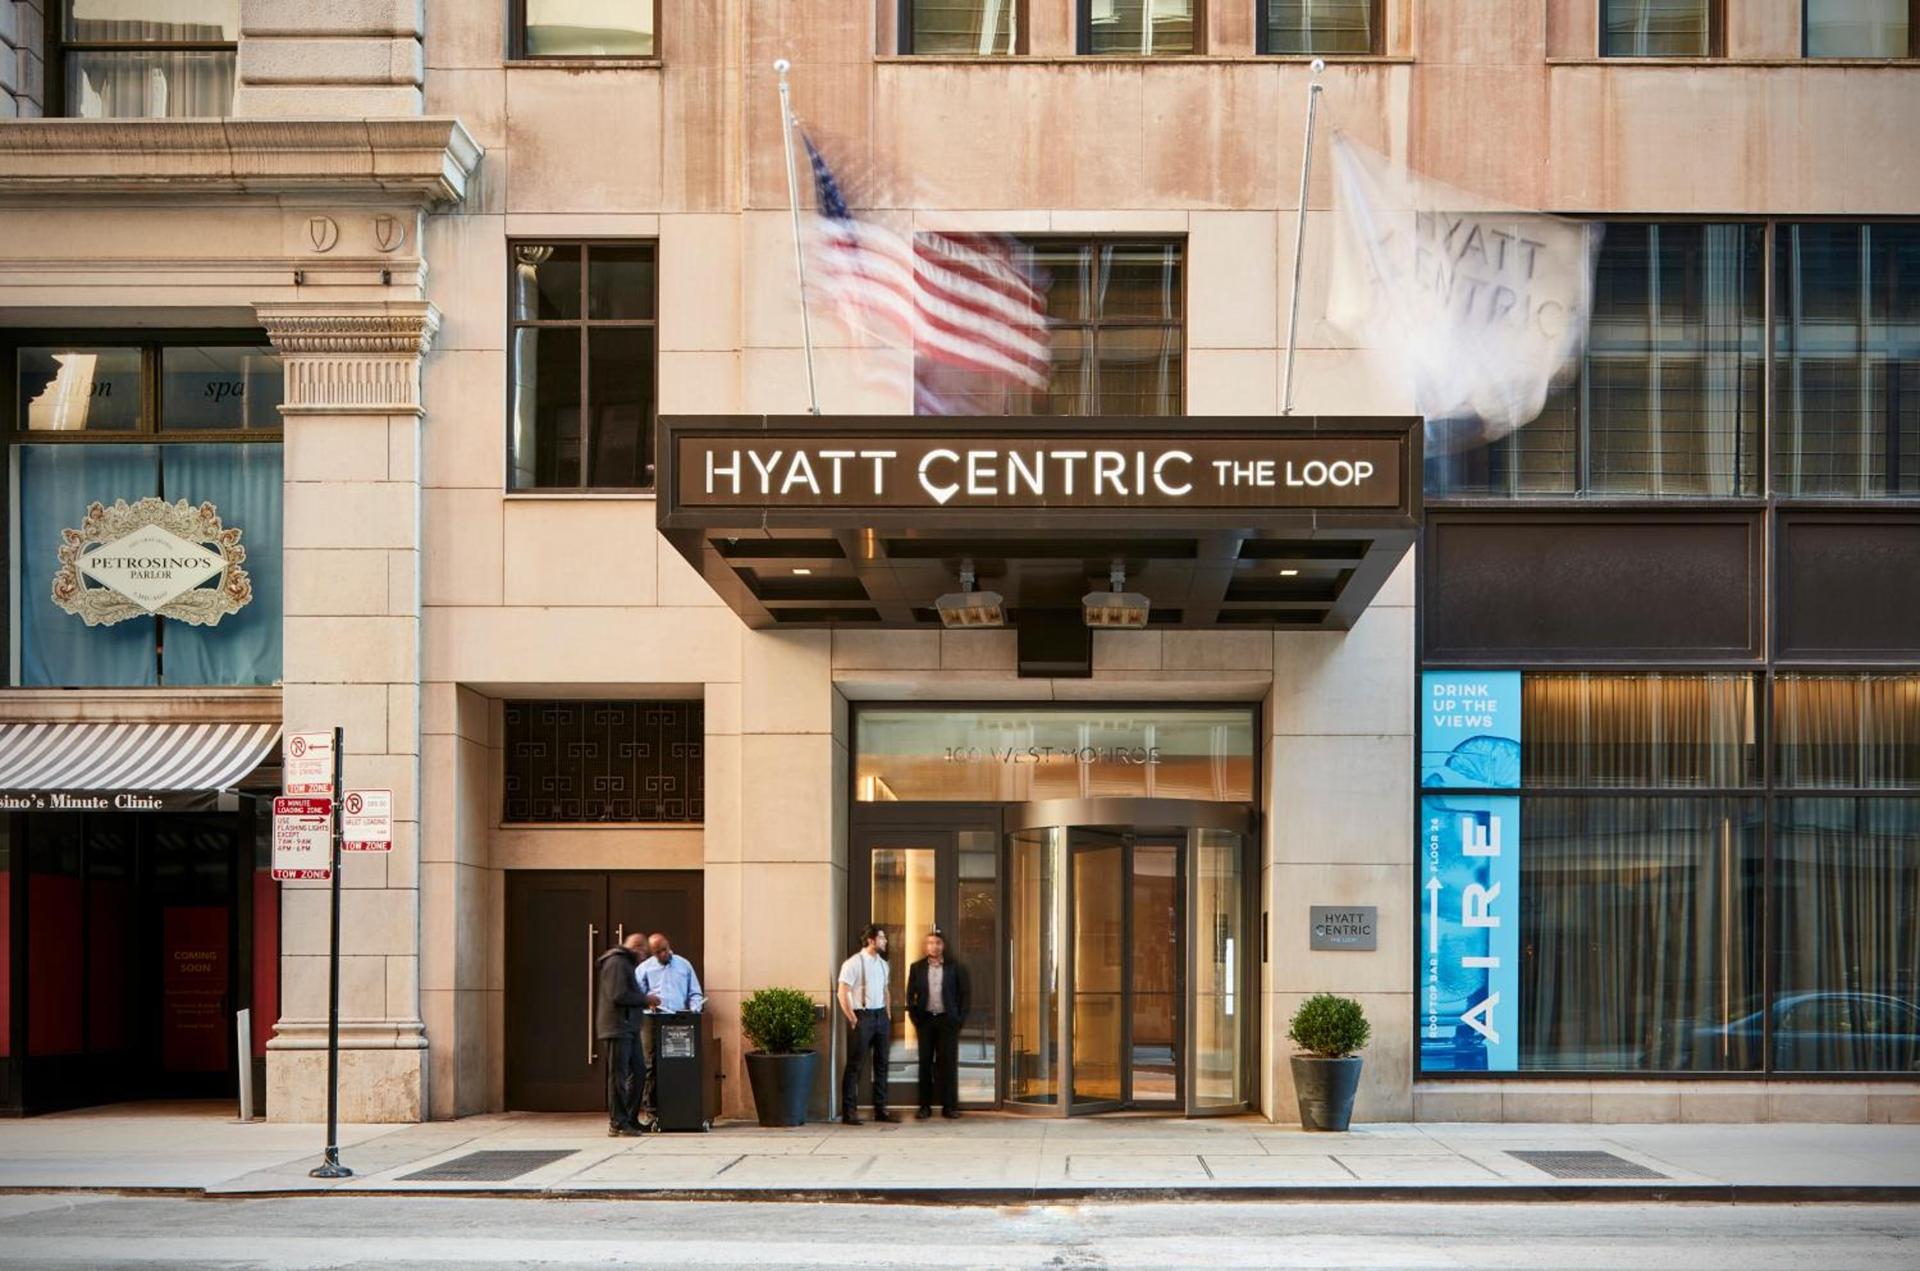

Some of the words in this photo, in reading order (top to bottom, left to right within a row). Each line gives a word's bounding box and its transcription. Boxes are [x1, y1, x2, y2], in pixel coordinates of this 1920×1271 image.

[204, 380, 246, 402] spa
[705, 450, 897, 495] HYATT
[918, 449, 1193, 504] CENTRIC
[1212, 461, 1275, 486] THE
[1286, 461, 1373, 486] LOOP
[91, 556, 212, 570] PETROSINO'S
[130, 570, 173, 580] PARLOR
[1433, 684, 1489, 697] DRINK
[1432, 700, 1456, 712] UP
[1461, 700, 1497, 712] THE
[1433, 715, 1493, 728] VIEWS
[992, 747, 1054, 764] WEST
[1061, 746, 1161, 765] MONROE
[289, 783, 306, 793] TOW
[309, 783, 329, 793] ZONE
[50, 794, 109, 809] Minute
[114, 794, 163, 809] Clinic
[287, 799, 311, 807] MINUTE
[345, 841, 362, 850] TOW
[366, 841, 387, 850] ZONE
[1430, 834, 1439, 873] FLOOR
[277, 870, 297, 879] TOW
[300, 870, 325, 879] ZONE
[1325, 913, 1365, 923] HYATT
[1316, 924, 1371, 936] CENTRIC
[1460, 816, 1501, 1045] AIRE
[173, 951, 218, 961] COMING
[181, 963, 212, 972] SOON
[1429, 958, 1438, 982] BAR
